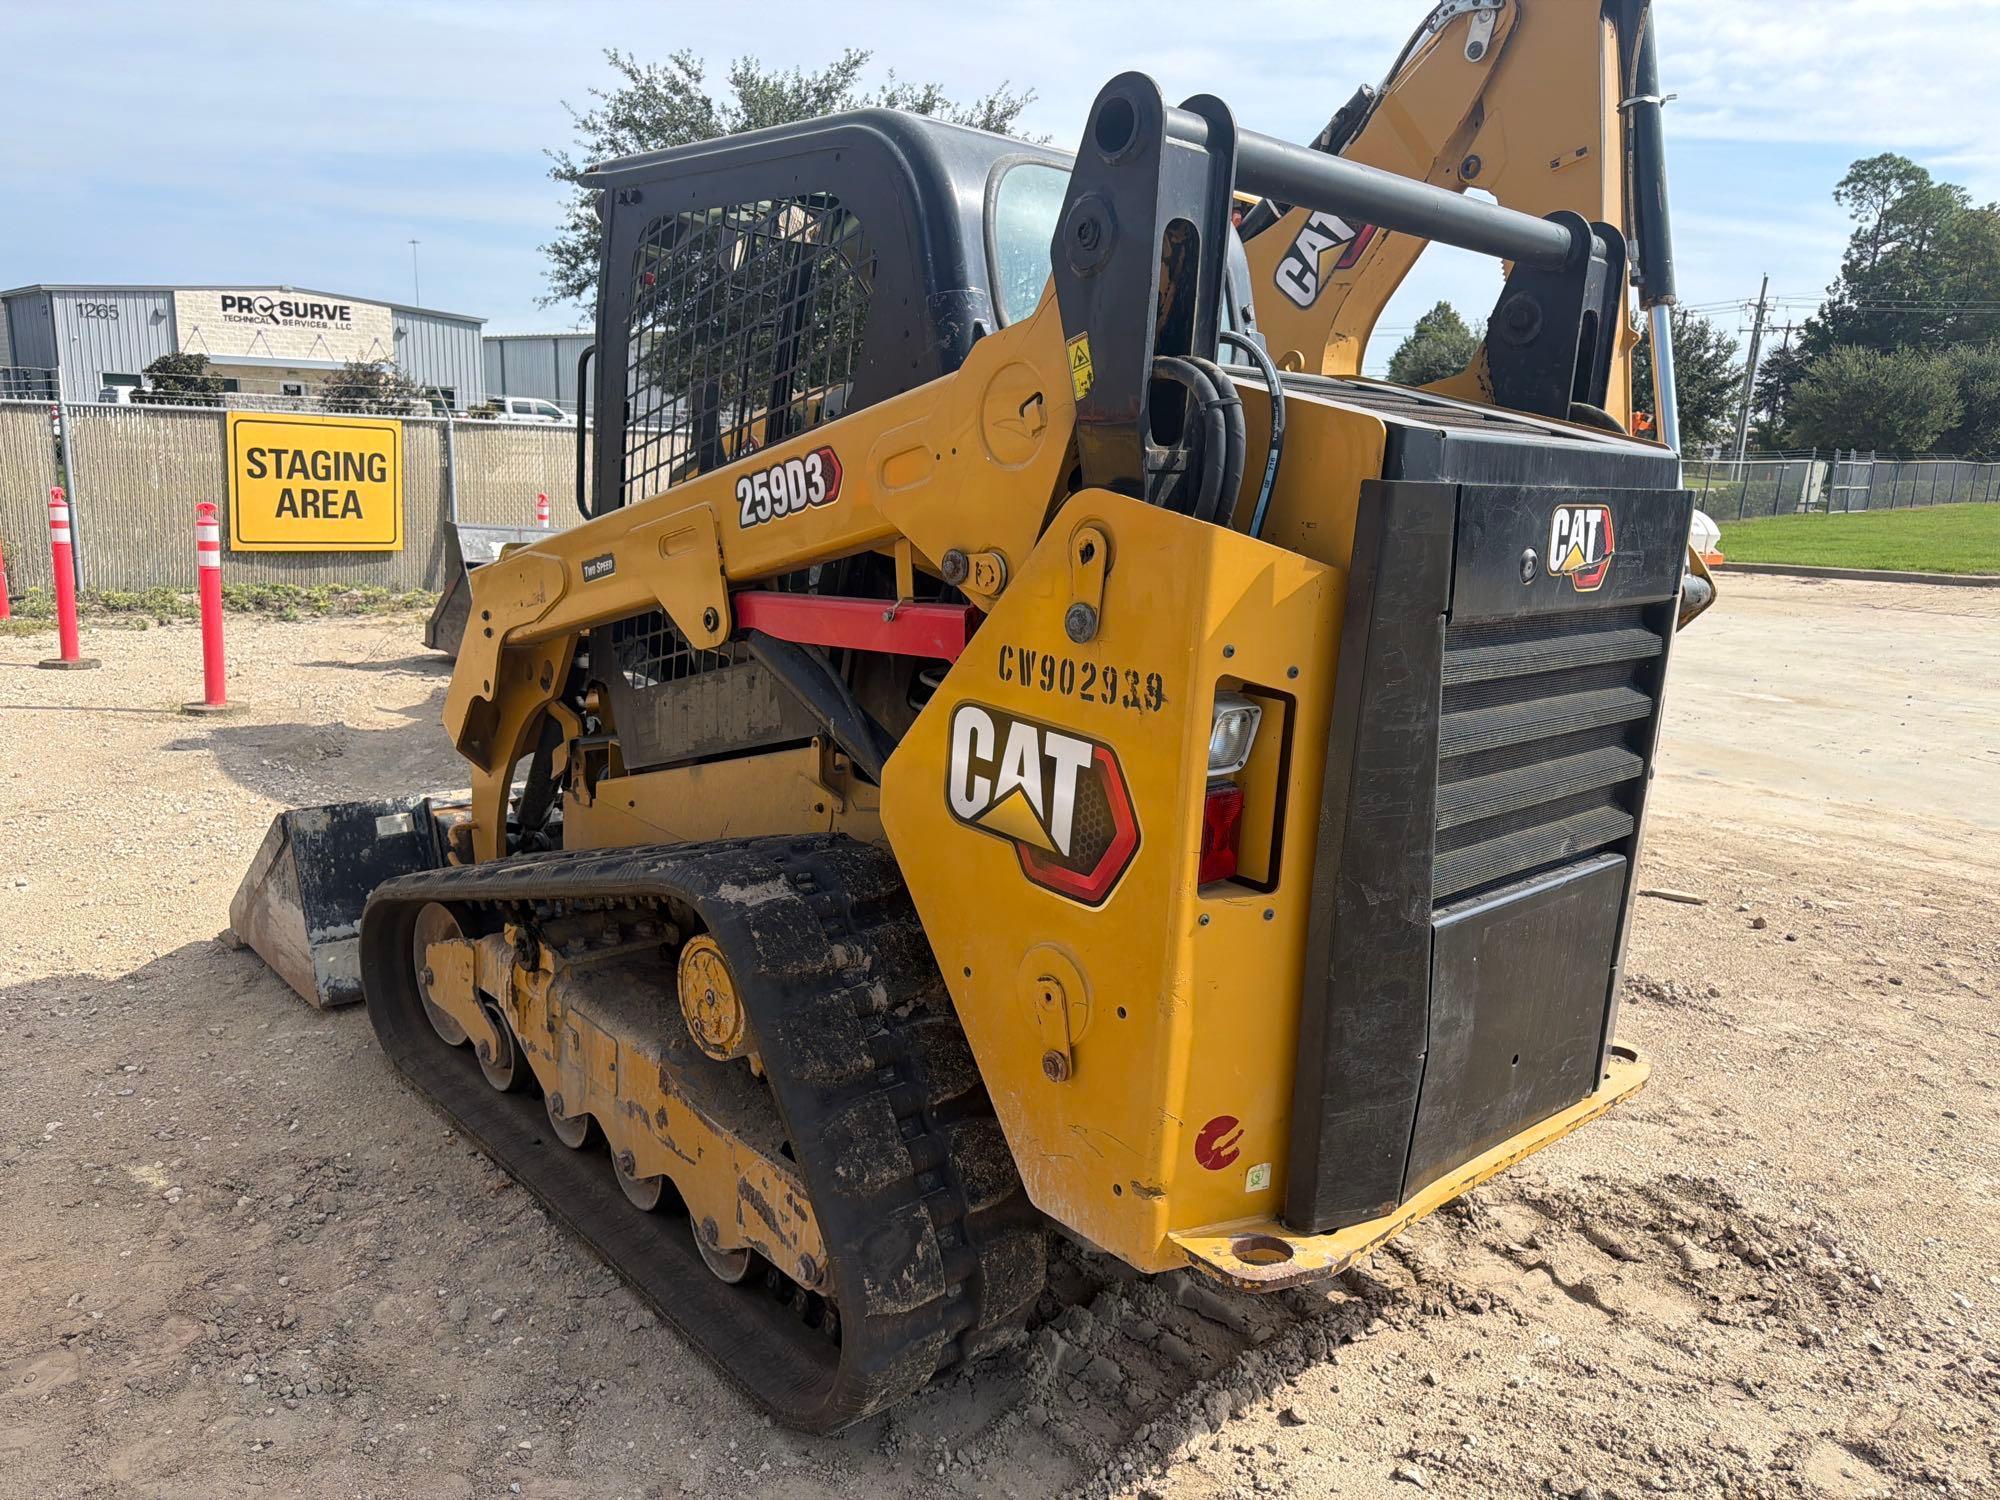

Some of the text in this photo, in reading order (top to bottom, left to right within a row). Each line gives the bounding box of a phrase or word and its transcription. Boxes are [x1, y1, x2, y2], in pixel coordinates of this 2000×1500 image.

[1276, 210, 1356, 307] CAT
[76, 303, 119, 320] 1265
[223, 315, 271, 325] TECHNICAL
[335, 322, 352, 331] LLC
[246, 447, 387, 483] STAGING
[737, 453, 826, 526] 259D3
[275, 488, 364, 520] AREA
[1549, 508, 1603, 572] CAT
[950, 706, 1093, 858] CAT
